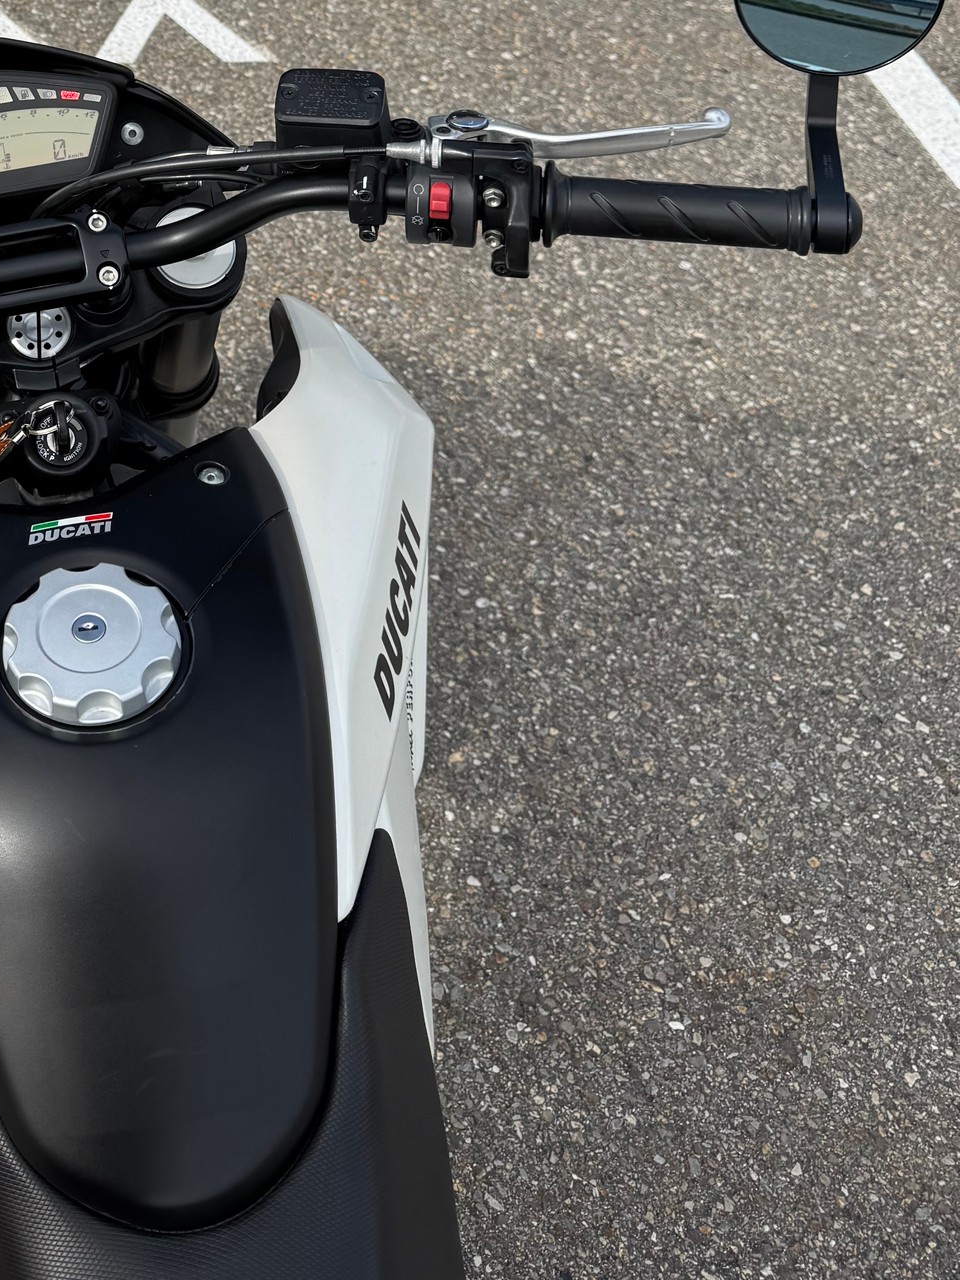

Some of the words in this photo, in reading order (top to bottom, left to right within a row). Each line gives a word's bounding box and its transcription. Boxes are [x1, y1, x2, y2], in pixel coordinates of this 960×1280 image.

[53, 138, 67, 160] 0
[40, 416, 51, 429] OFF
[36, 440, 50, 458] LOCK
[28, 521, 112, 546] DUCATI
[373, 499, 421, 723] DUCATI
